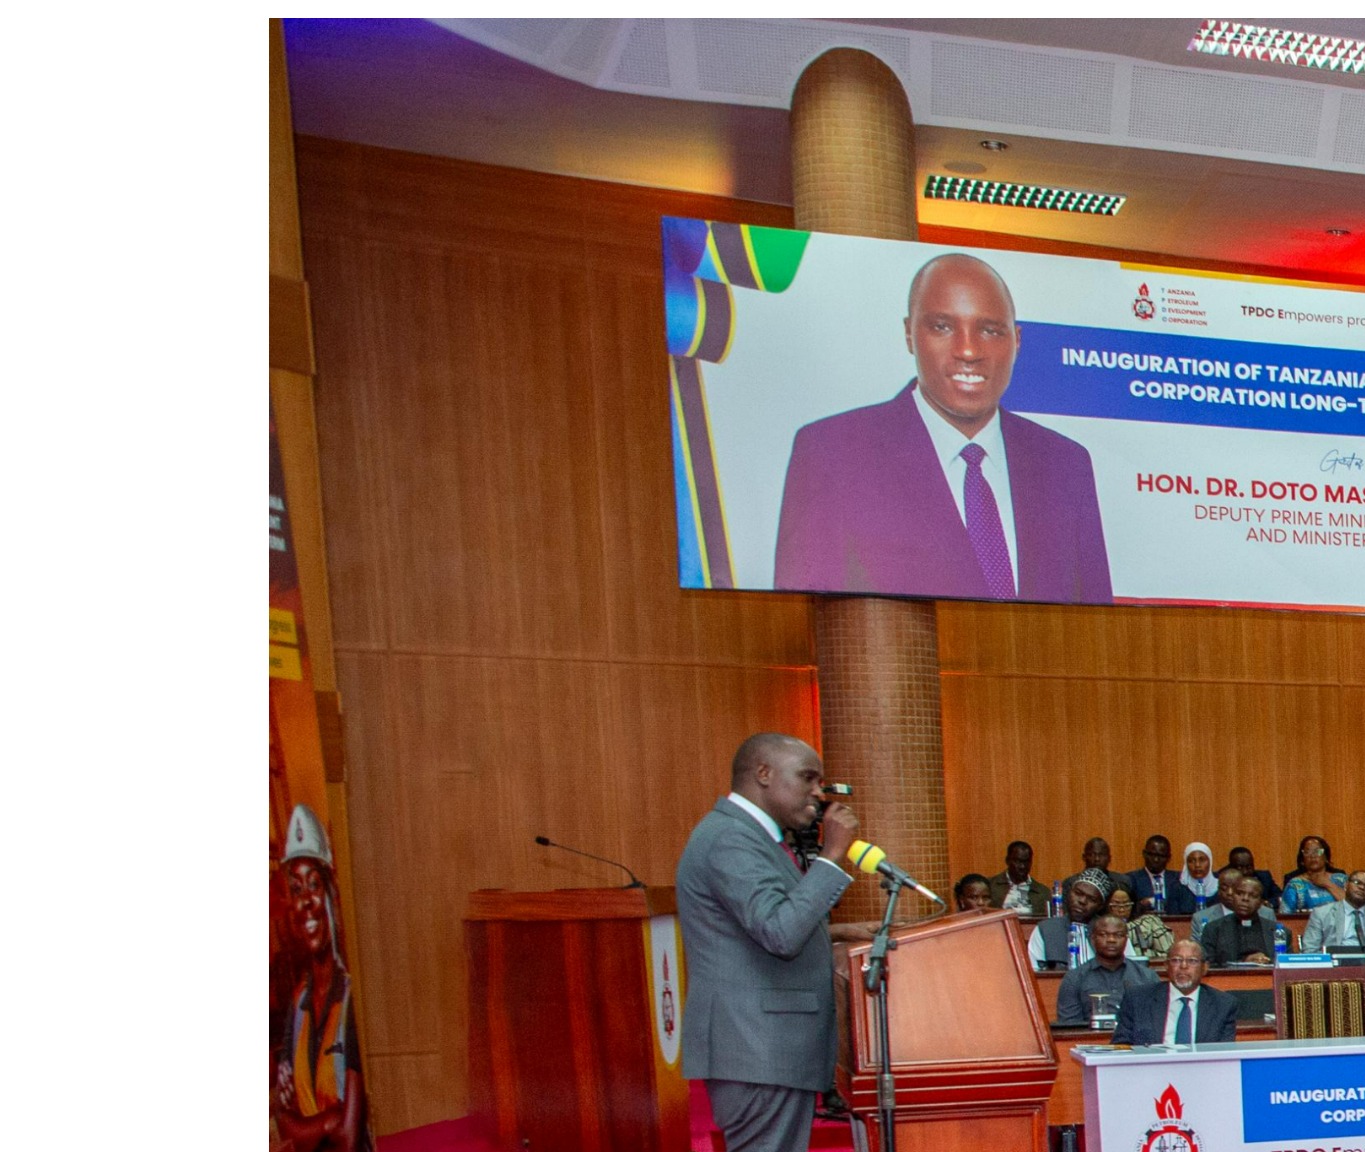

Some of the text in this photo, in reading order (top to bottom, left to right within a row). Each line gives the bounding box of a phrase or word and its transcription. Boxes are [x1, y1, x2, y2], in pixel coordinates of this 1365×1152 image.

[1240, 305, 1274, 318] TPDC
[1278, 308, 1342, 323] Empowers
[1062, 348, 1230, 378] INAUGURATION
[1234, 363, 1262, 380] OF
[1130, 380, 1286, 408] CORPORATION
[1137, 473, 1199, 494] HON.
[1206, 477, 1244, 497] DR.
[1251, 480, 1317, 501] DOTO
[1194, 505, 1264, 522] DEPUTY
[1272, 509, 1322, 525] PRIME
[1246, 527, 1286, 543] AND
